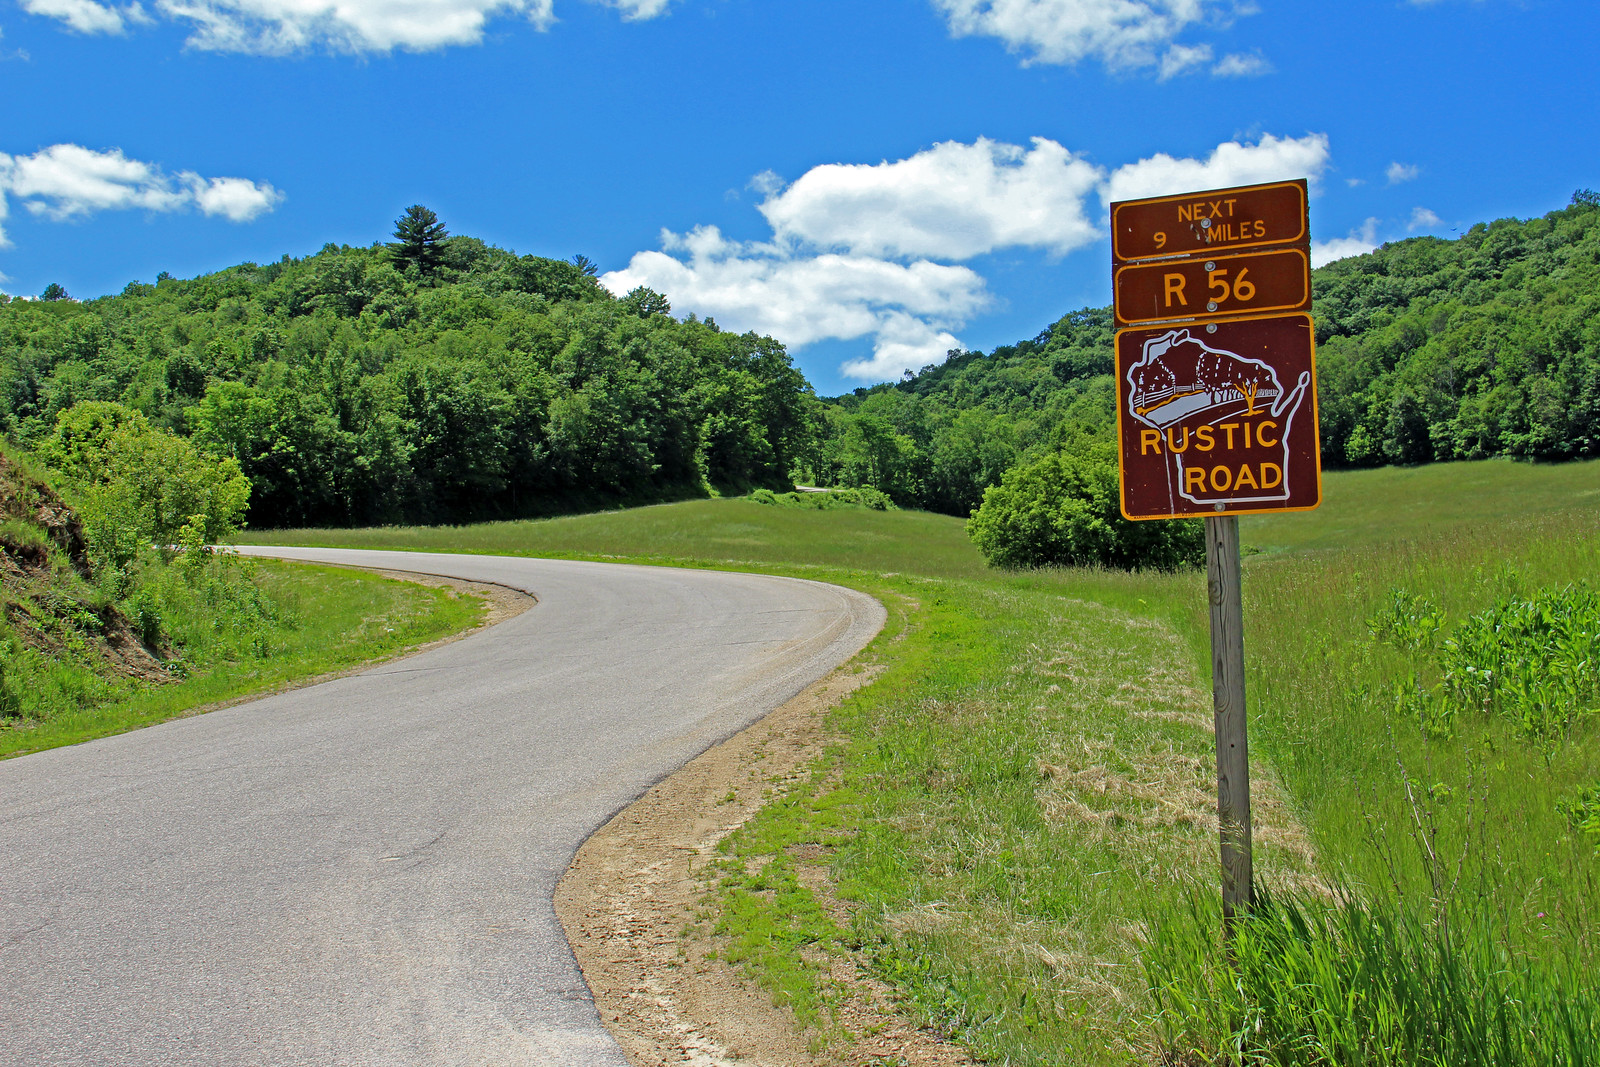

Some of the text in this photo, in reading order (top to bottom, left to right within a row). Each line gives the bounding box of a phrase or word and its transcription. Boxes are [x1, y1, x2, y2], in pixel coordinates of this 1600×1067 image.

[1178, 199, 1237, 222] NEXT
[1153, 220, 1266, 249] 9 MILES
[1164, 267, 1256, 307] R 56
[1140, 421, 1278, 455] RUSTIC
[1185, 462, 1282, 493] ROAD
